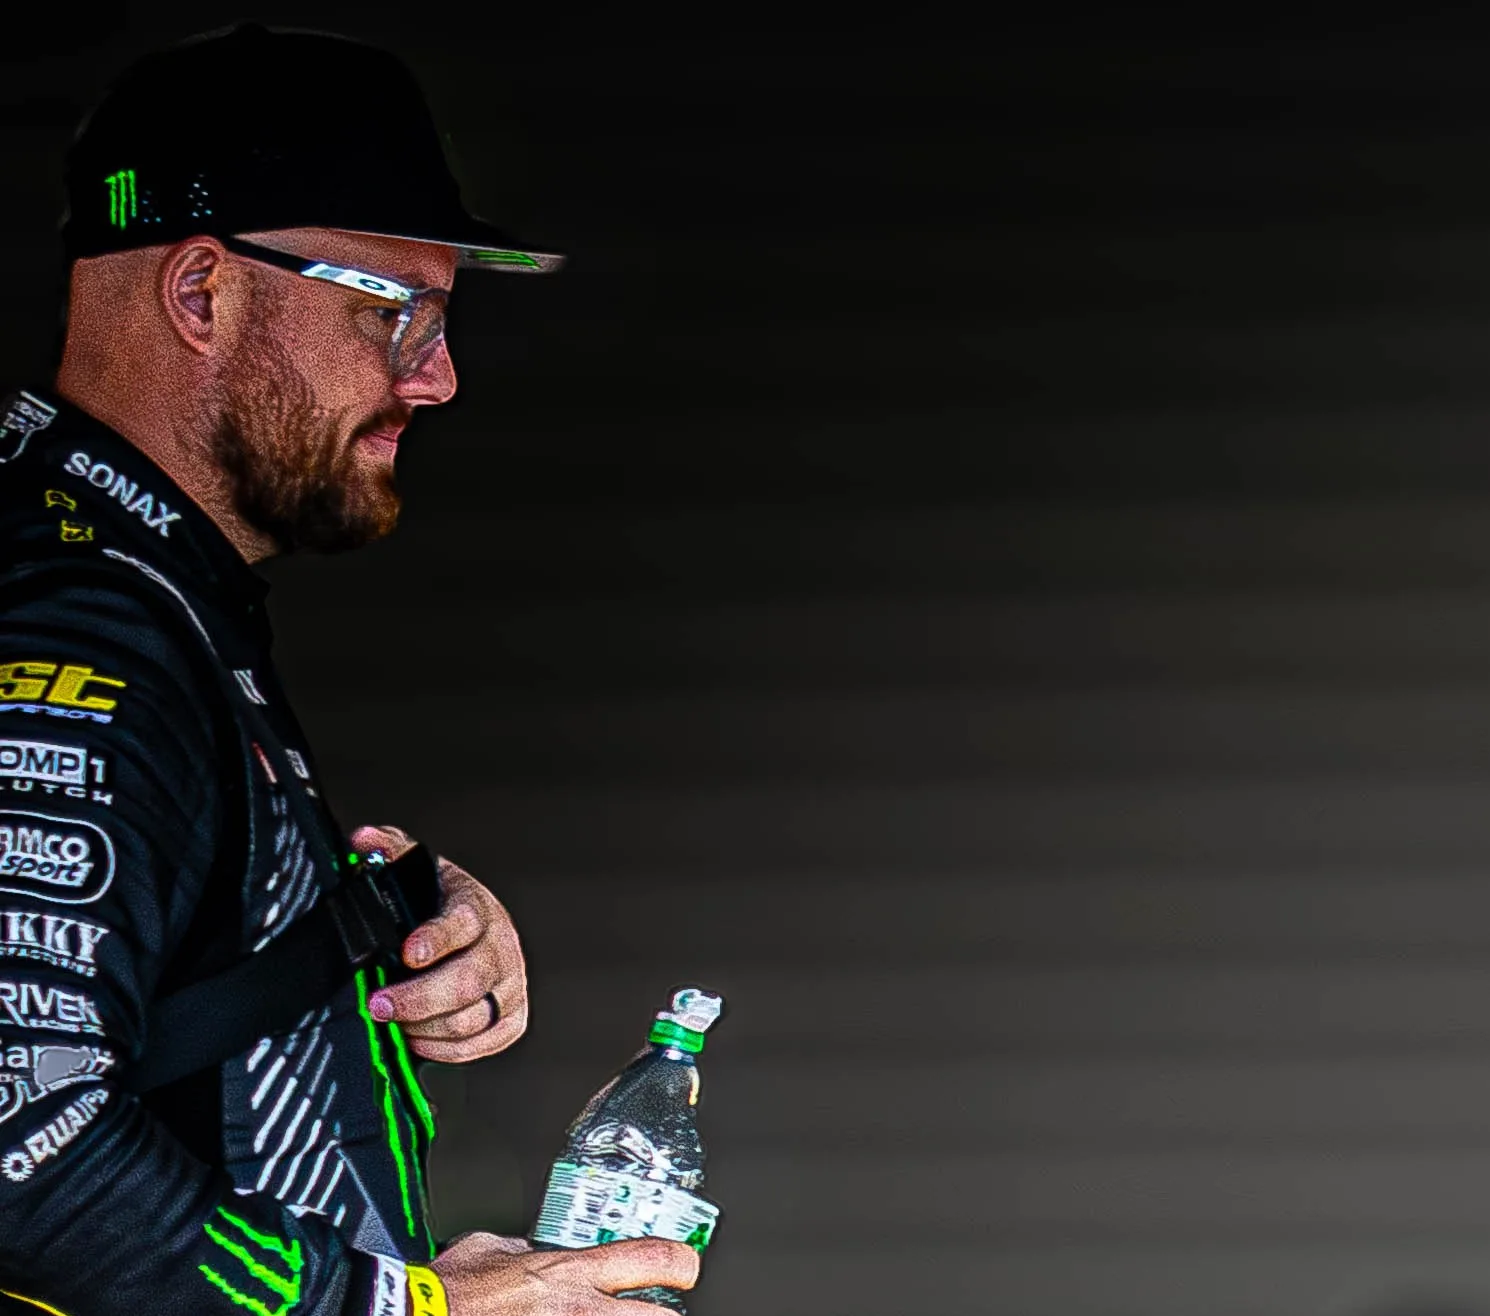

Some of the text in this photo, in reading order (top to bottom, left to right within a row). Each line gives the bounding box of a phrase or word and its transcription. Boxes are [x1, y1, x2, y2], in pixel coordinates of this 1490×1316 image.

[64, 453, 181, 537] SONAX
[0, 745, 81, 777] OMP
[0, 779, 113, 806] UTCH
[0, 827, 90, 863] AMCO
